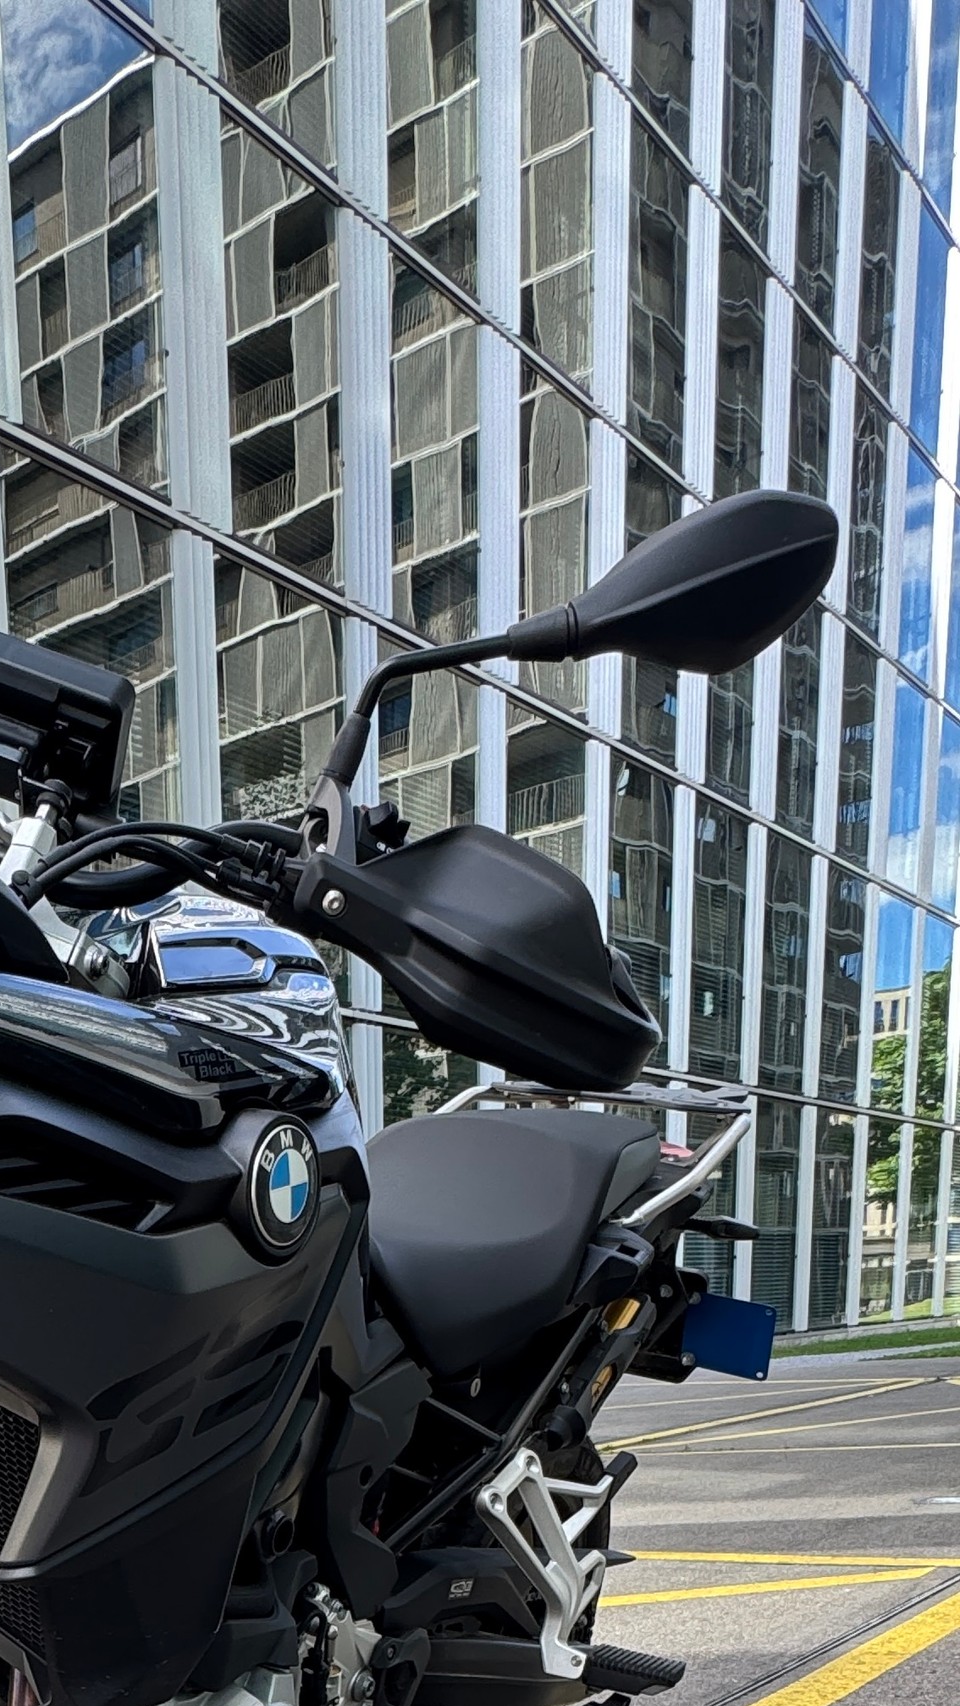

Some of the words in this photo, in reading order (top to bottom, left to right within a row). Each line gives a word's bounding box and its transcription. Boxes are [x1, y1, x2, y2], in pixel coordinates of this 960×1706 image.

[180, 1050, 217, 1066] Triple
[199, 1061, 234, 1078] Black
[260, 1129, 313, 1173] BMW
